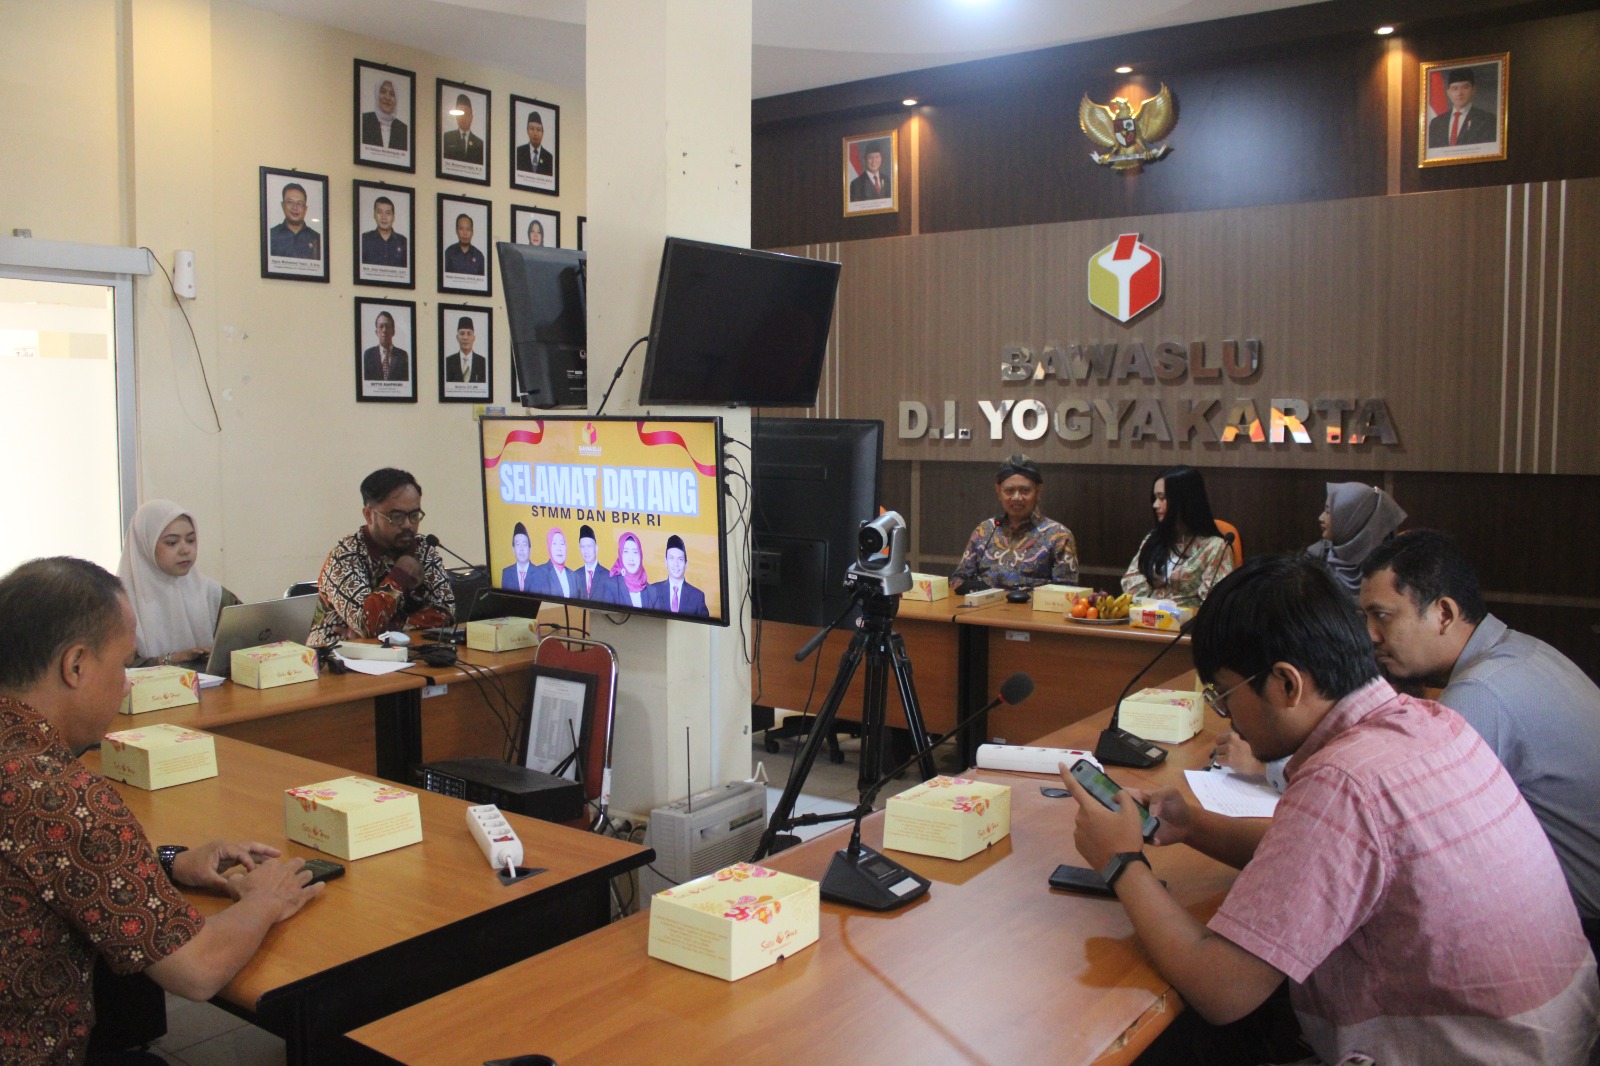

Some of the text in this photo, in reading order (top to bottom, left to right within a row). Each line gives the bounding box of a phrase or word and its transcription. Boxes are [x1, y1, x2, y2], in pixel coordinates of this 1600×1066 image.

[1001, 339, 1261, 382] BAWASLU
[898, 398, 1399, 446] D.I. YOGYAKARTA
[578, 445, 602, 453] BAWASLU
[499, 462, 698, 514] SELAMAT DATANG
[531, 505, 661, 527] STMM DAN BPK RI
